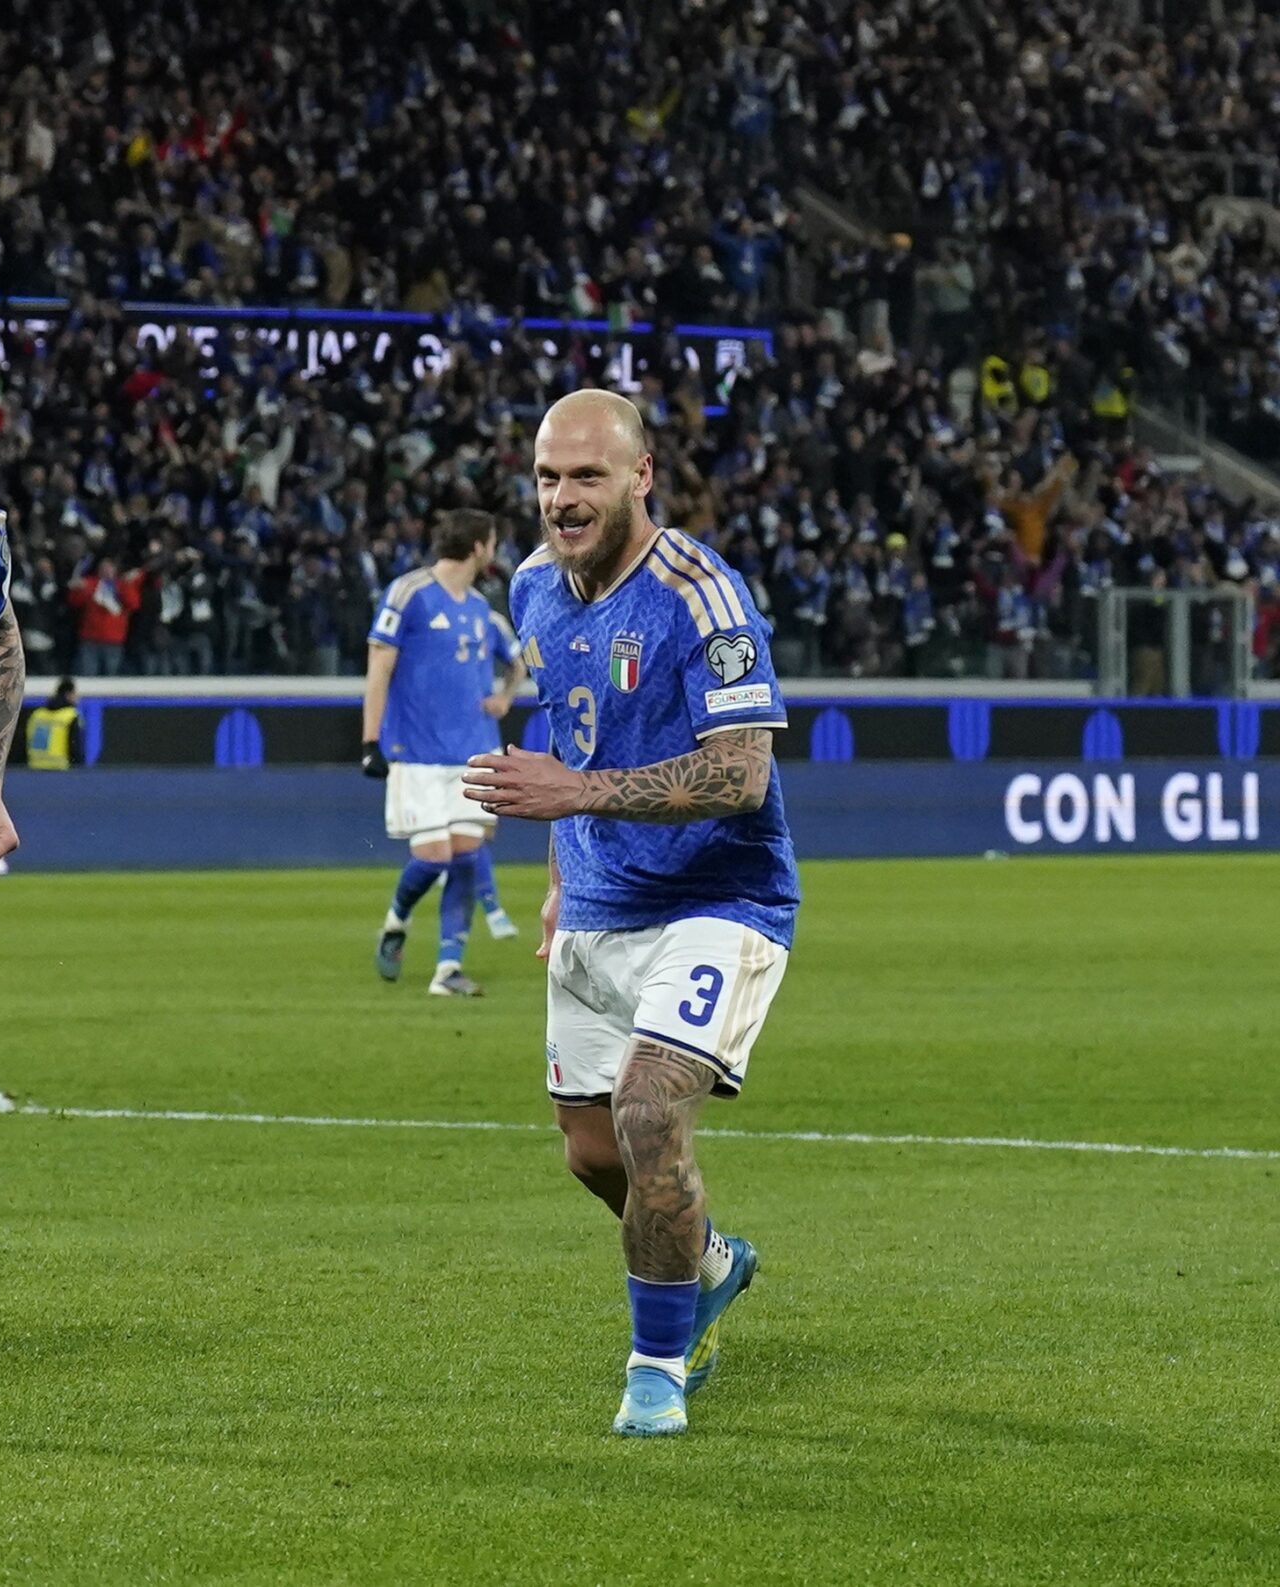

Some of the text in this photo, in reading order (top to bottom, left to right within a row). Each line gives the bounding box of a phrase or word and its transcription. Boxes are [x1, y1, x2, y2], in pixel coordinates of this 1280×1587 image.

[613, 642, 639, 655] ITALIA
[568, 685, 597, 755] 3
[708, 691, 770, 704] FOUNDATION
[1005, 772, 1260, 843] CON GLI
[679, 965, 723, 1026] 3
